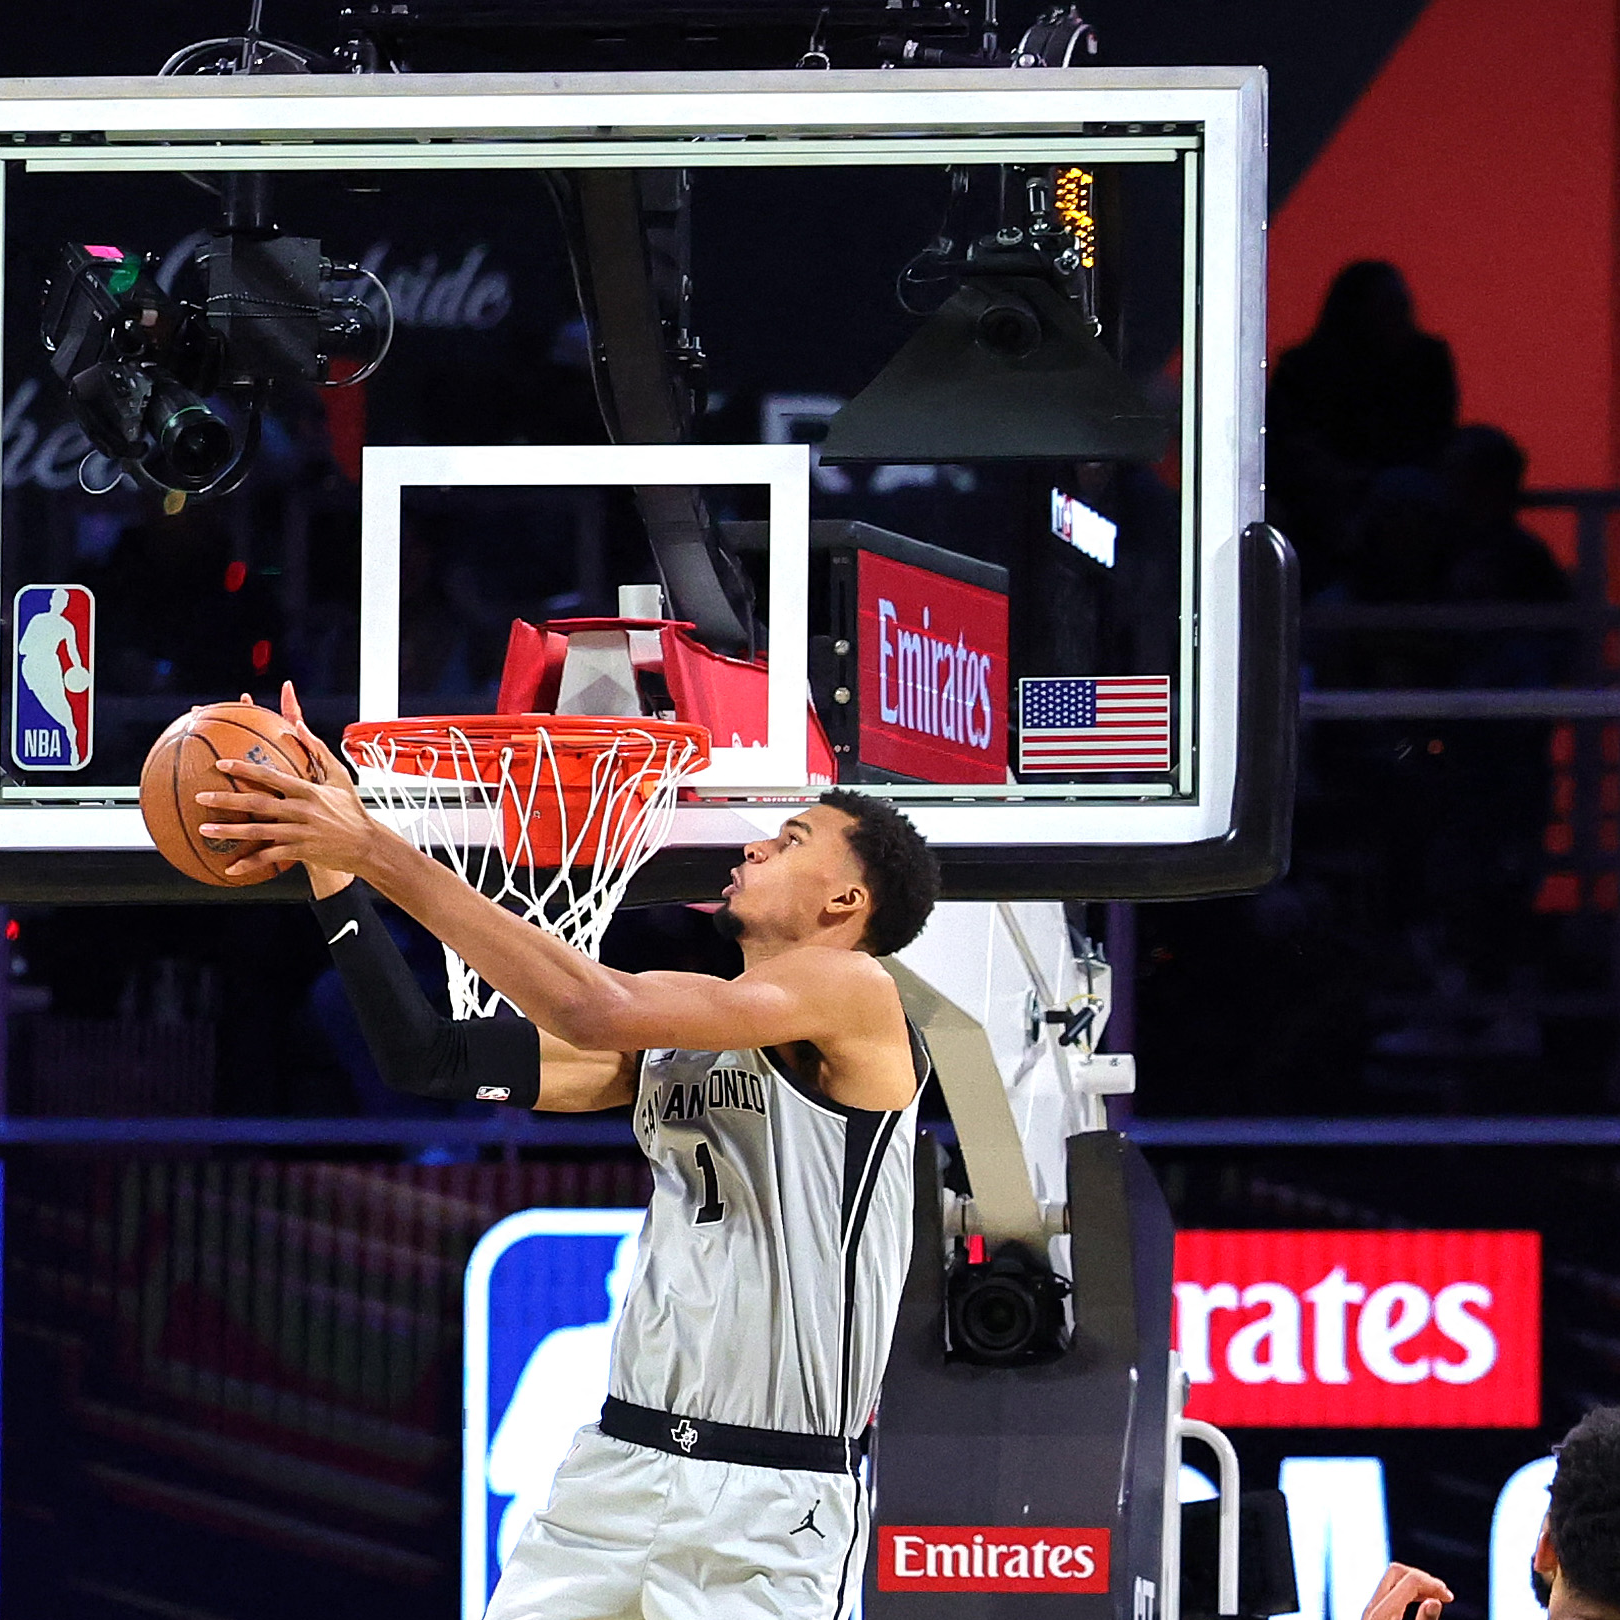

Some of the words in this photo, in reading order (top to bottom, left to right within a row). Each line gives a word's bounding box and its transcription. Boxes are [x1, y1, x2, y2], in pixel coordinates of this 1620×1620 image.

[878, 598, 992, 750] Emirates
[24, 729, 61, 758] NBA
[693, 1141, 727, 1226] 1
[1174, 1266, 1499, 1384] rates
[893, 1534, 1096, 1579] Emirates
